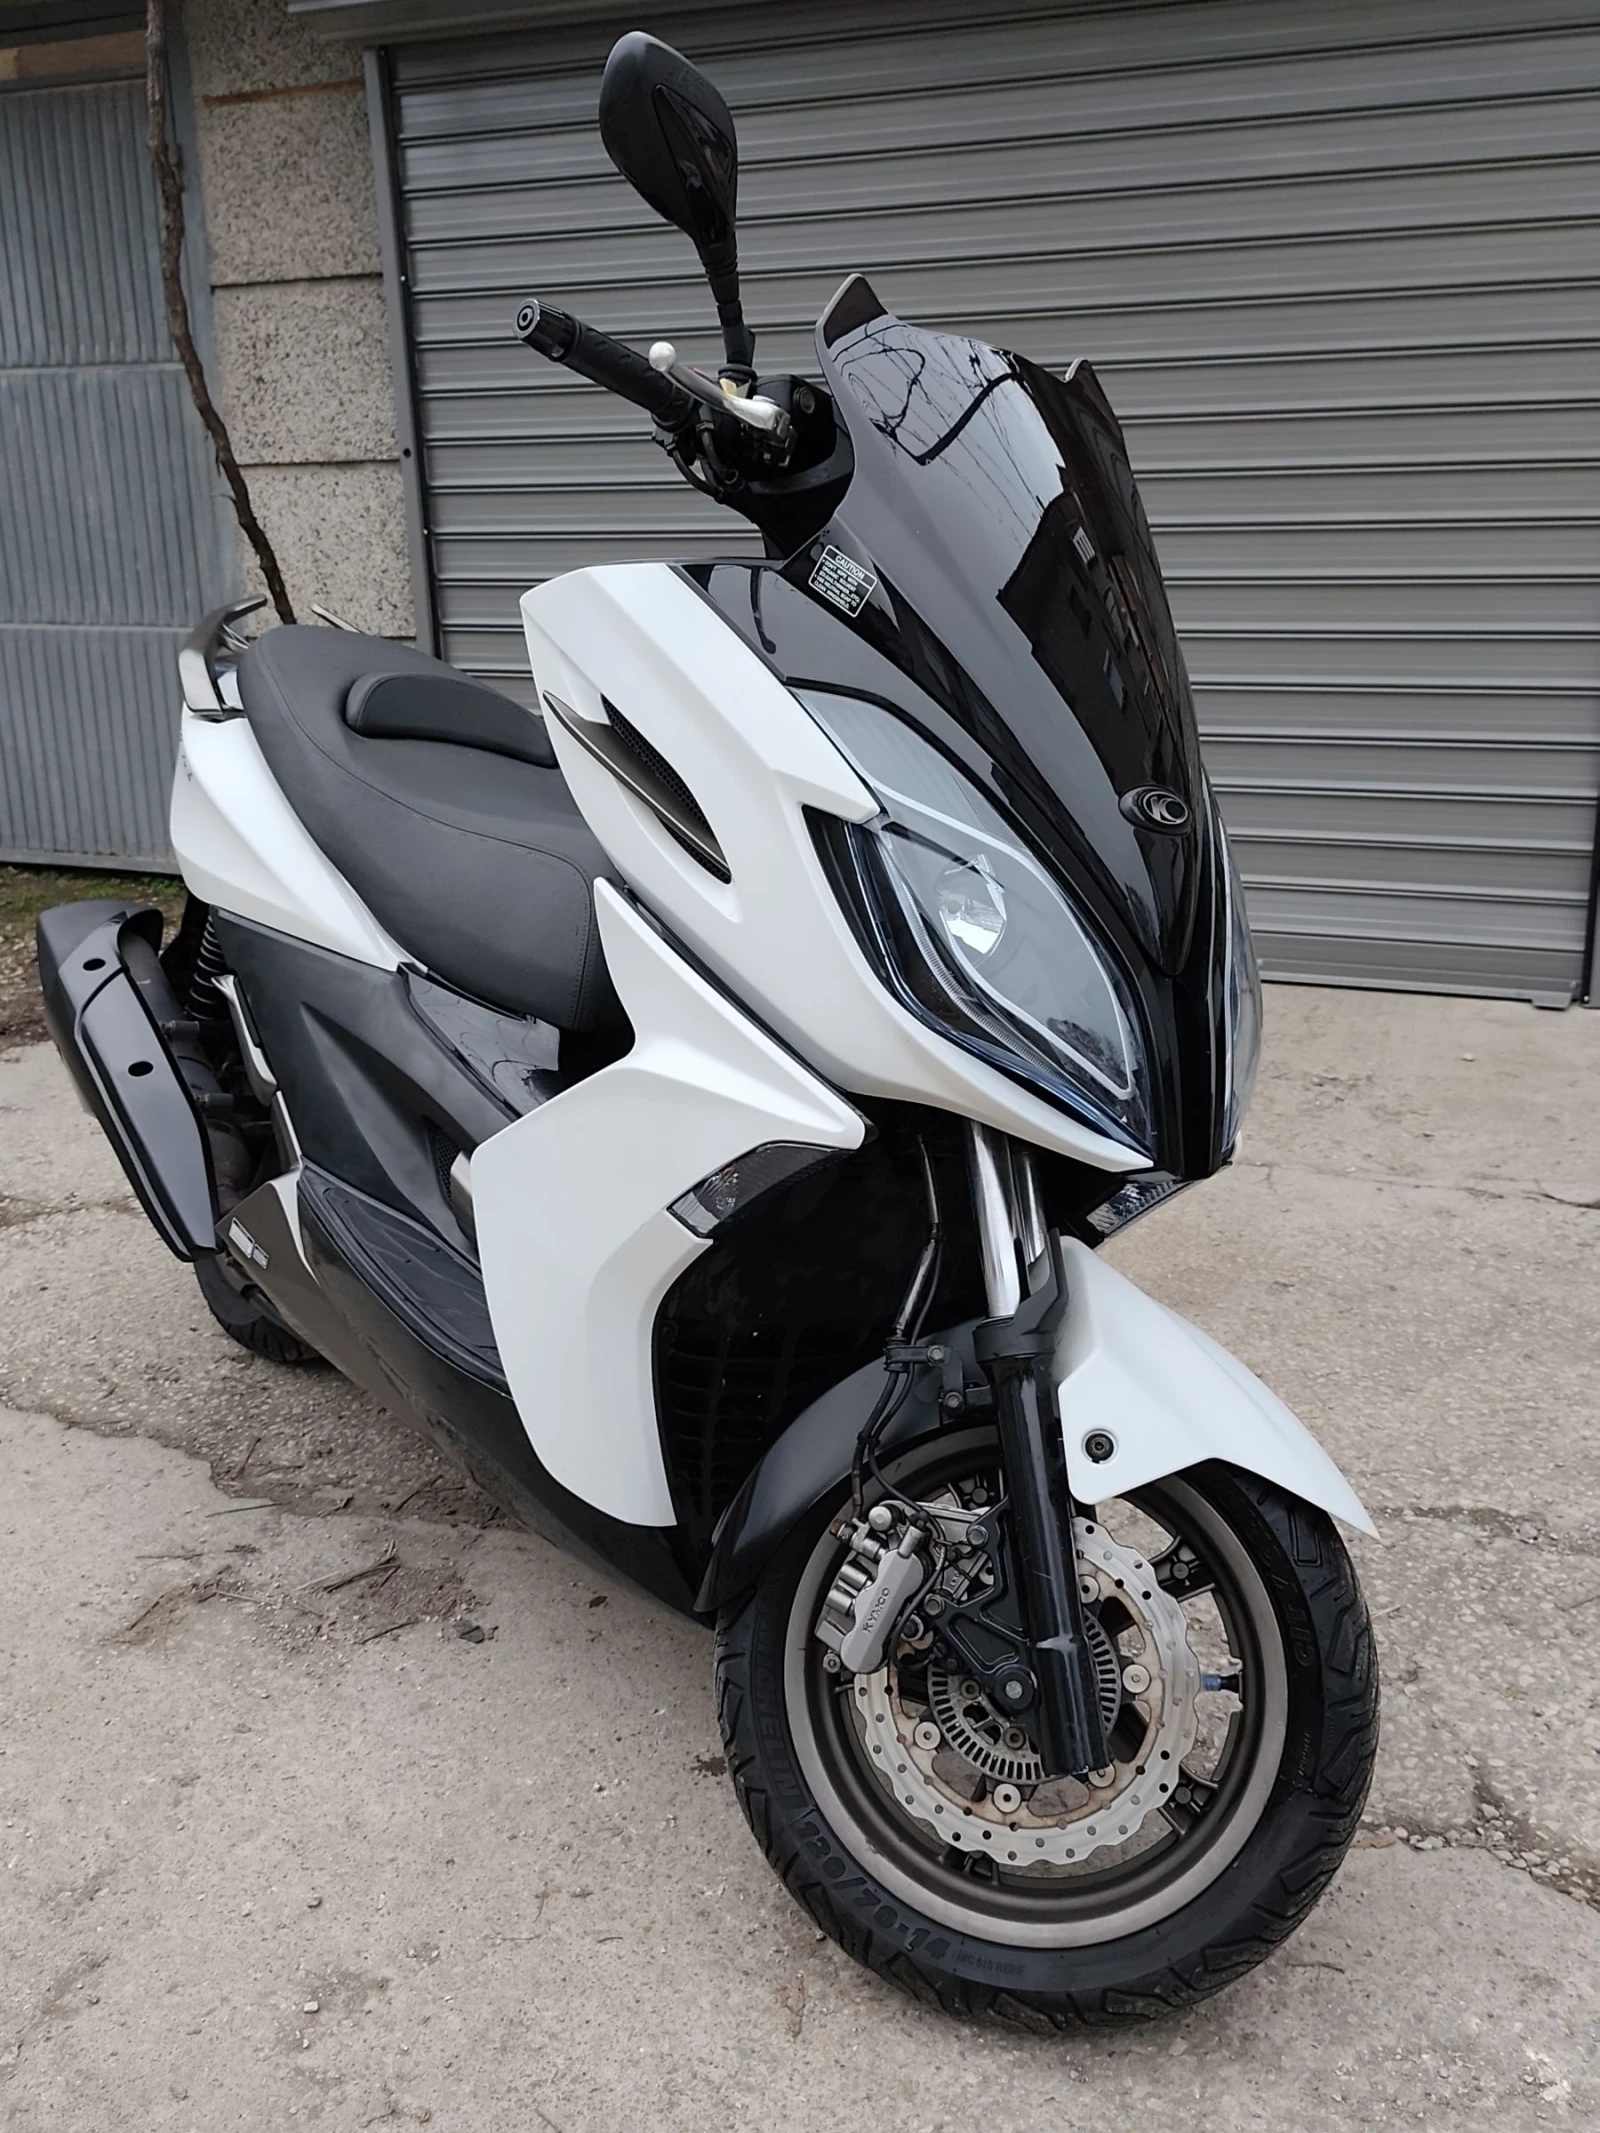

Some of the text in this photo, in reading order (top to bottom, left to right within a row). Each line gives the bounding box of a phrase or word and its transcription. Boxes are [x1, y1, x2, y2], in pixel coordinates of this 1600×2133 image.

[835, 555, 865, 580] CAUTION
[862, 1587, 890, 1633] KYMCO
[753, 1614, 803, 1799] MICHELIN
[797, 1821, 951, 1960] 120/70-14
